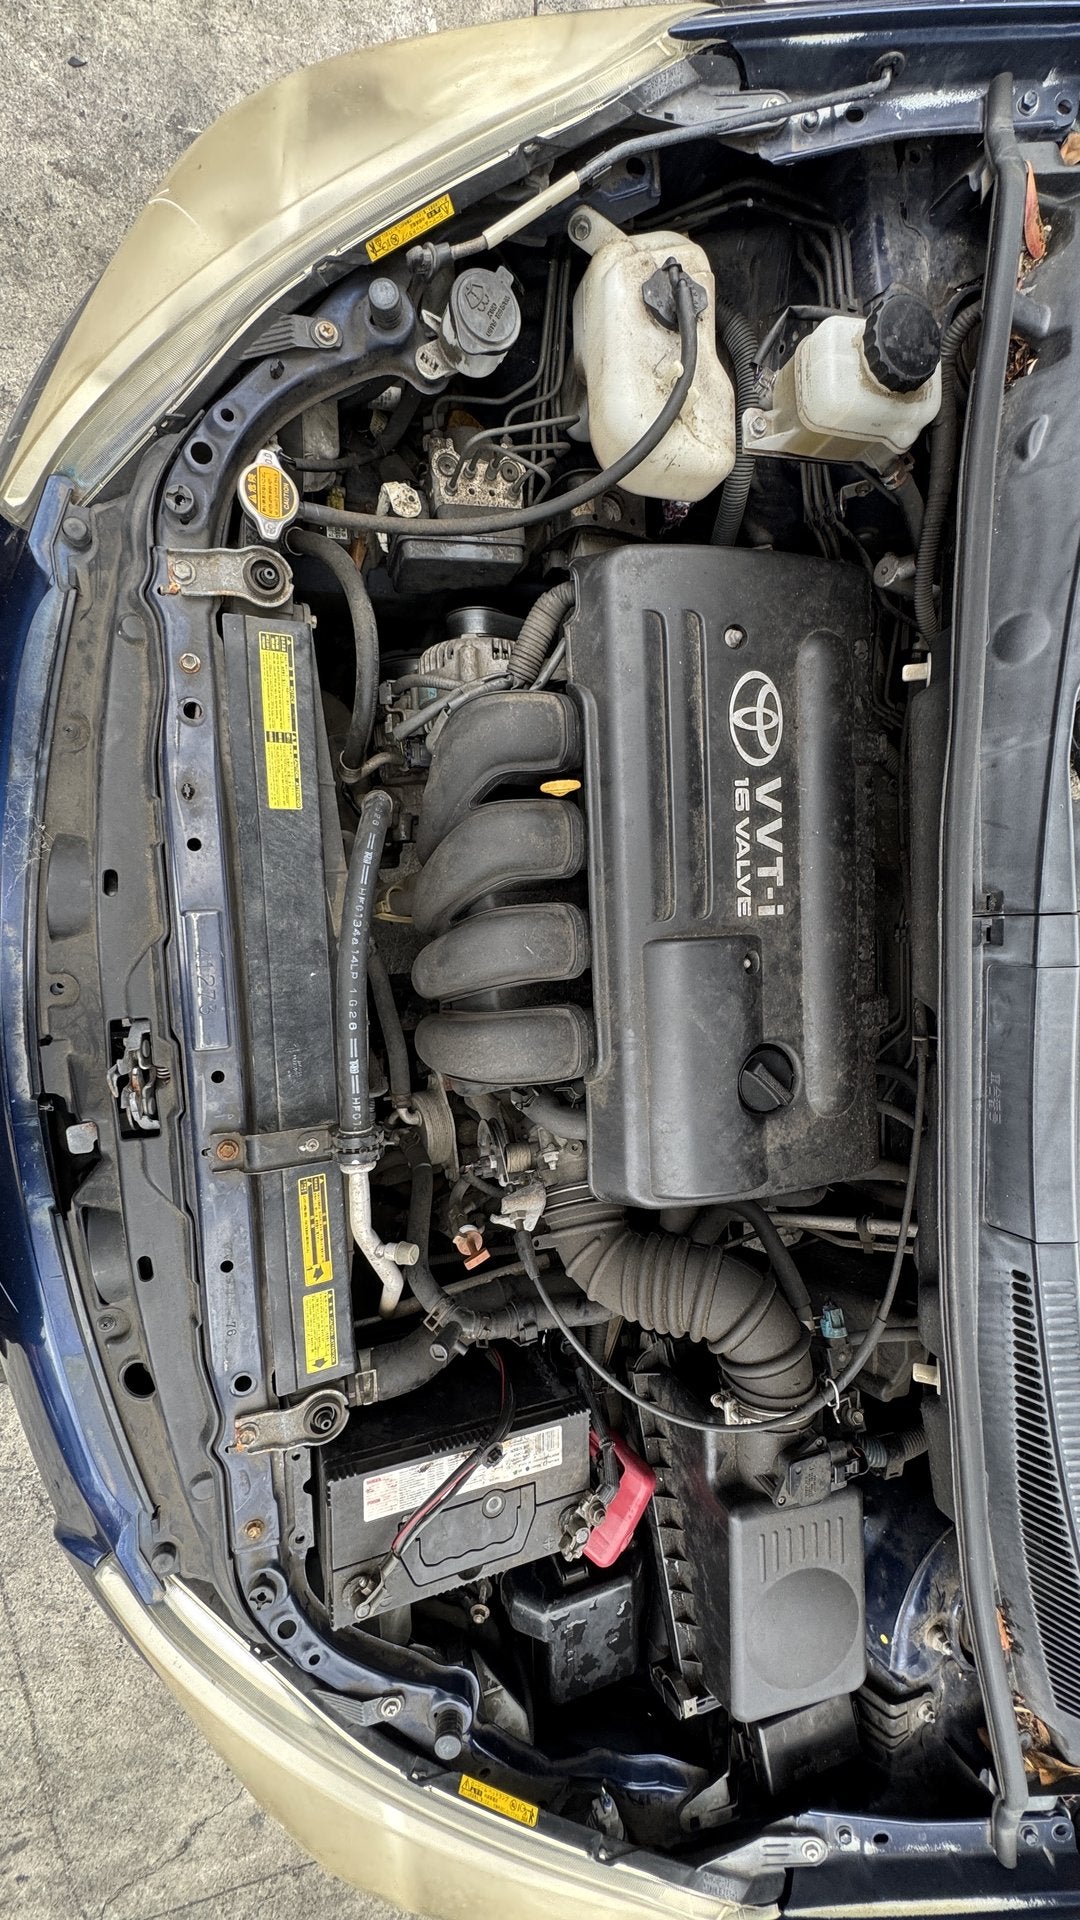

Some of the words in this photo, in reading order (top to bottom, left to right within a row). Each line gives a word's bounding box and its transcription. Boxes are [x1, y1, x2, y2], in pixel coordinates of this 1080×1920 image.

[734, 778, 750, 811] 16
[735, 817, 751, 917] VALVE
[755, 776, 784, 916] VVT-i
[349, 950, 360, 979] 14LP
